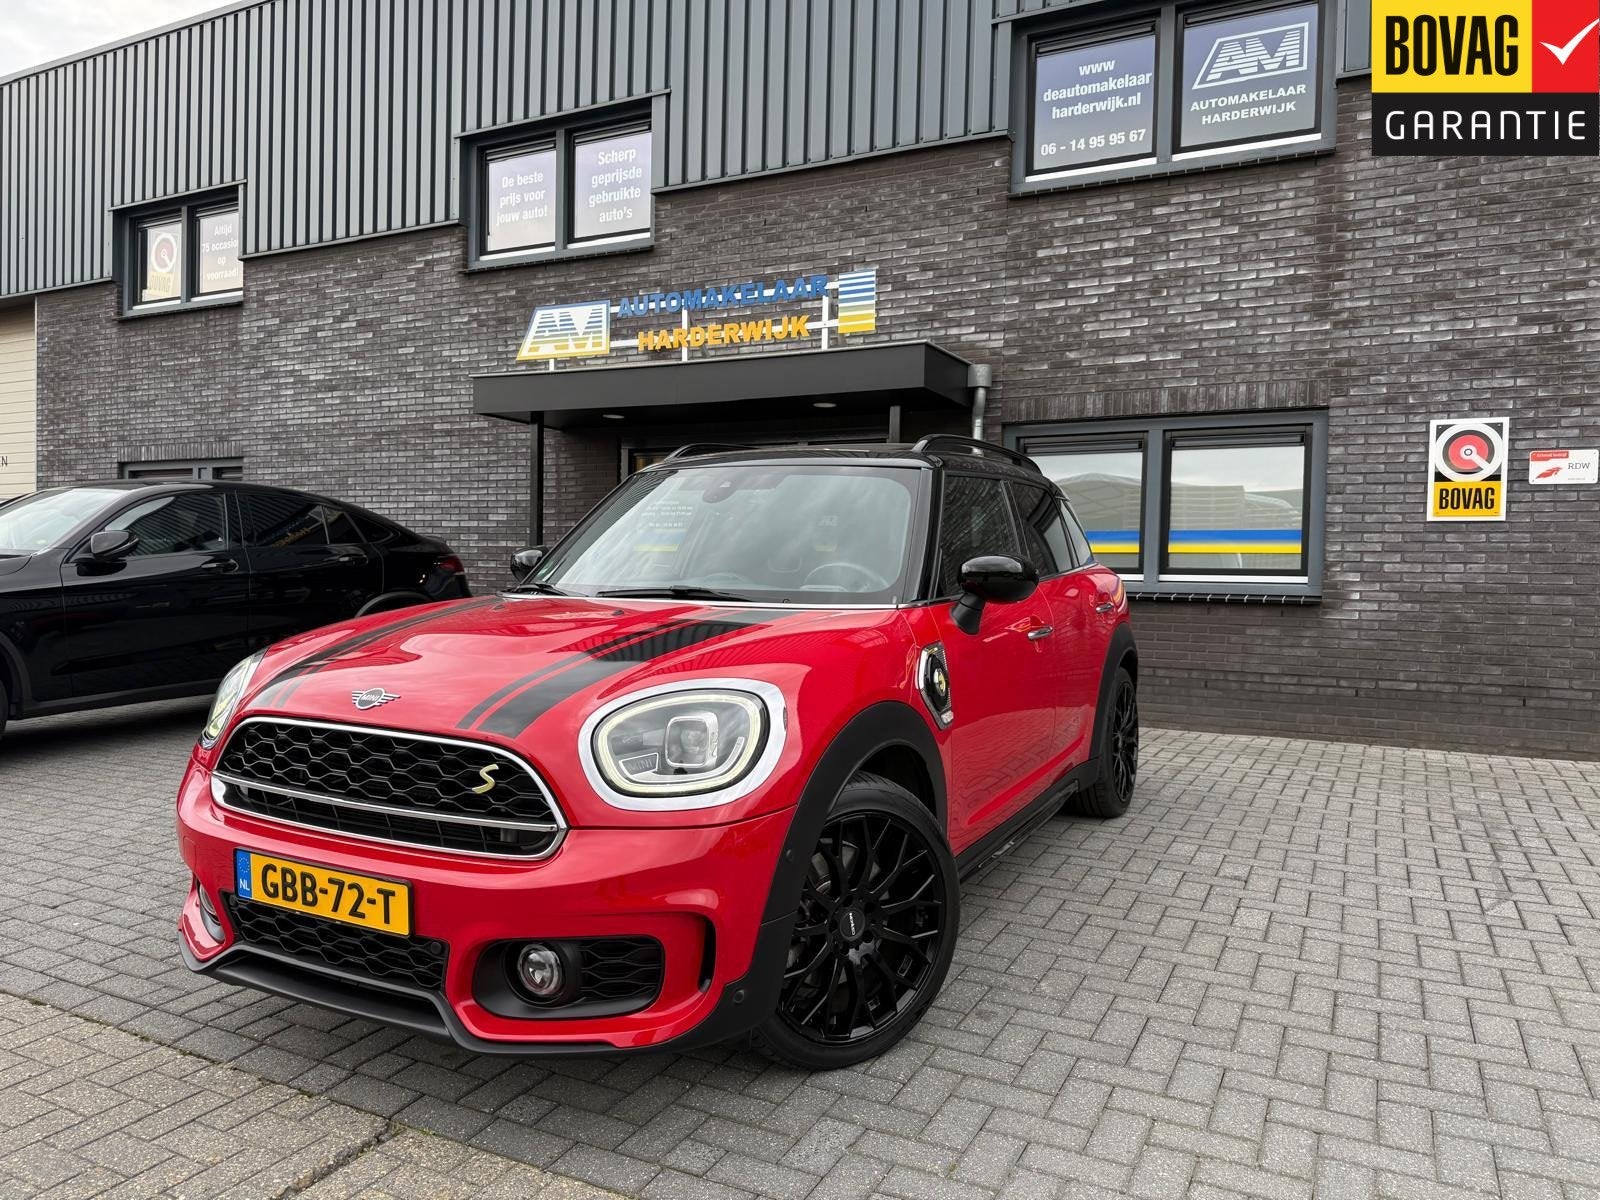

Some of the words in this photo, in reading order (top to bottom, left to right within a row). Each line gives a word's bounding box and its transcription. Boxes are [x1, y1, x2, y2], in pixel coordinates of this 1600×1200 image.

[1206, 27, 1301, 81] AM
[1079, 58, 1116, 76] www
[1043, 72, 1153, 102] deautomakelaar
[1190, 84, 1306, 112] AUTOMAKELAAR
[1052, 93, 1141, 119] harderwijk.nl
[1202, 102, 1296, 125] HARDERWIJK
[1041, 143, 1057, 156] 06
[1069, 139, 1086, 152] 14
[1089, 136, 1106, 149] 95
[1109, 132, 1126, 146] 95
[1129, 129, 1146, 143] 67
[598, 149, 636, 165] Scherp
[502, 176, 514, 188] De
[517, 172, 544, 186] beste
[591, 167, 642, 187] geprijsde
[499, 193, 521, 209] prijs
[524, 189, 546, 202] voor
[588, 187, 641, 207] gebruikte
[496, 210, 520, 226] jouw
[522, 205, 548, 220] auto!
[599, 207, 633, 222] auto's
[617, 274, 829, 319] AUTOMAKELAAR
[527, 308, 603, 353] AM
[637, 315, 810, 351] HARDERWIJK
[1567, 462, 1591, 470] RDW
[1439, 487, 1495, 510] BOVAG
[239, 879, 250, 892] NL
[261, 863, 396, 924] GBB-72-T
